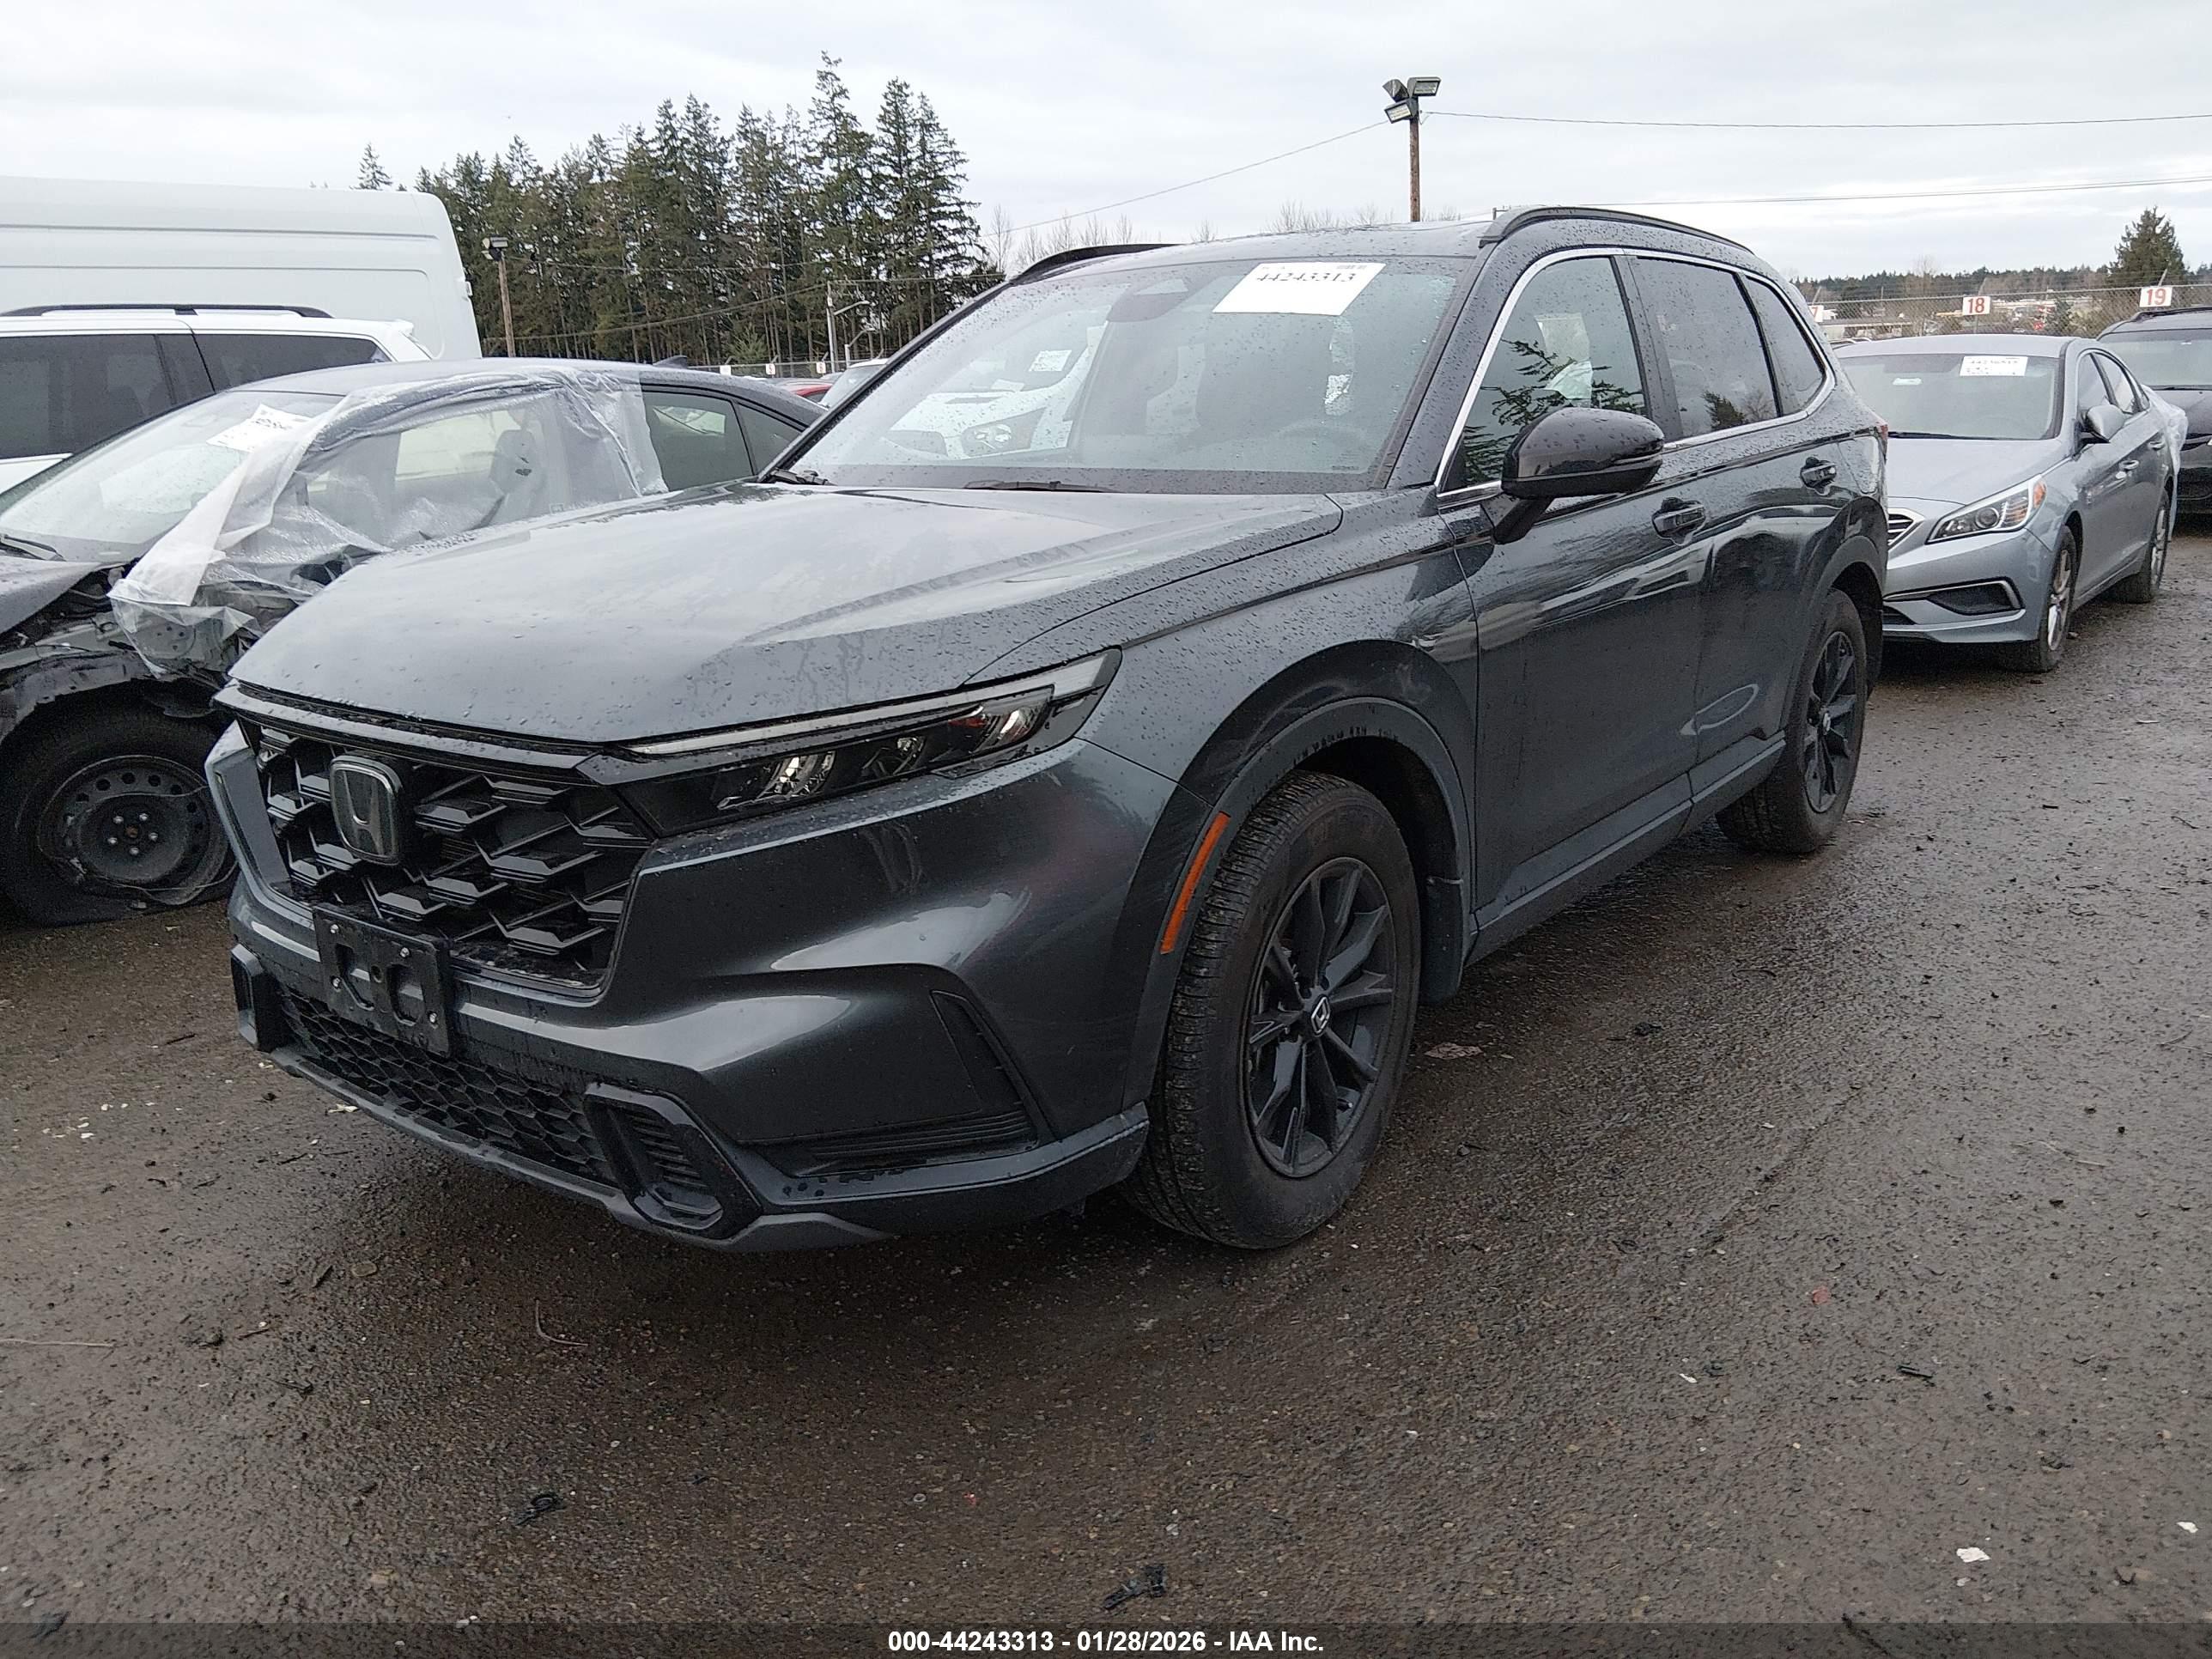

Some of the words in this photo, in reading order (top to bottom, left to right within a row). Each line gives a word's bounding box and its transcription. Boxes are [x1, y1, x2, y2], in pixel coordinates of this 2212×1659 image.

[1256, 272, 1357, 283] 44243313
[2147, 288, 2166, 305] 19
[1967, 297, 1984, 313] 18
